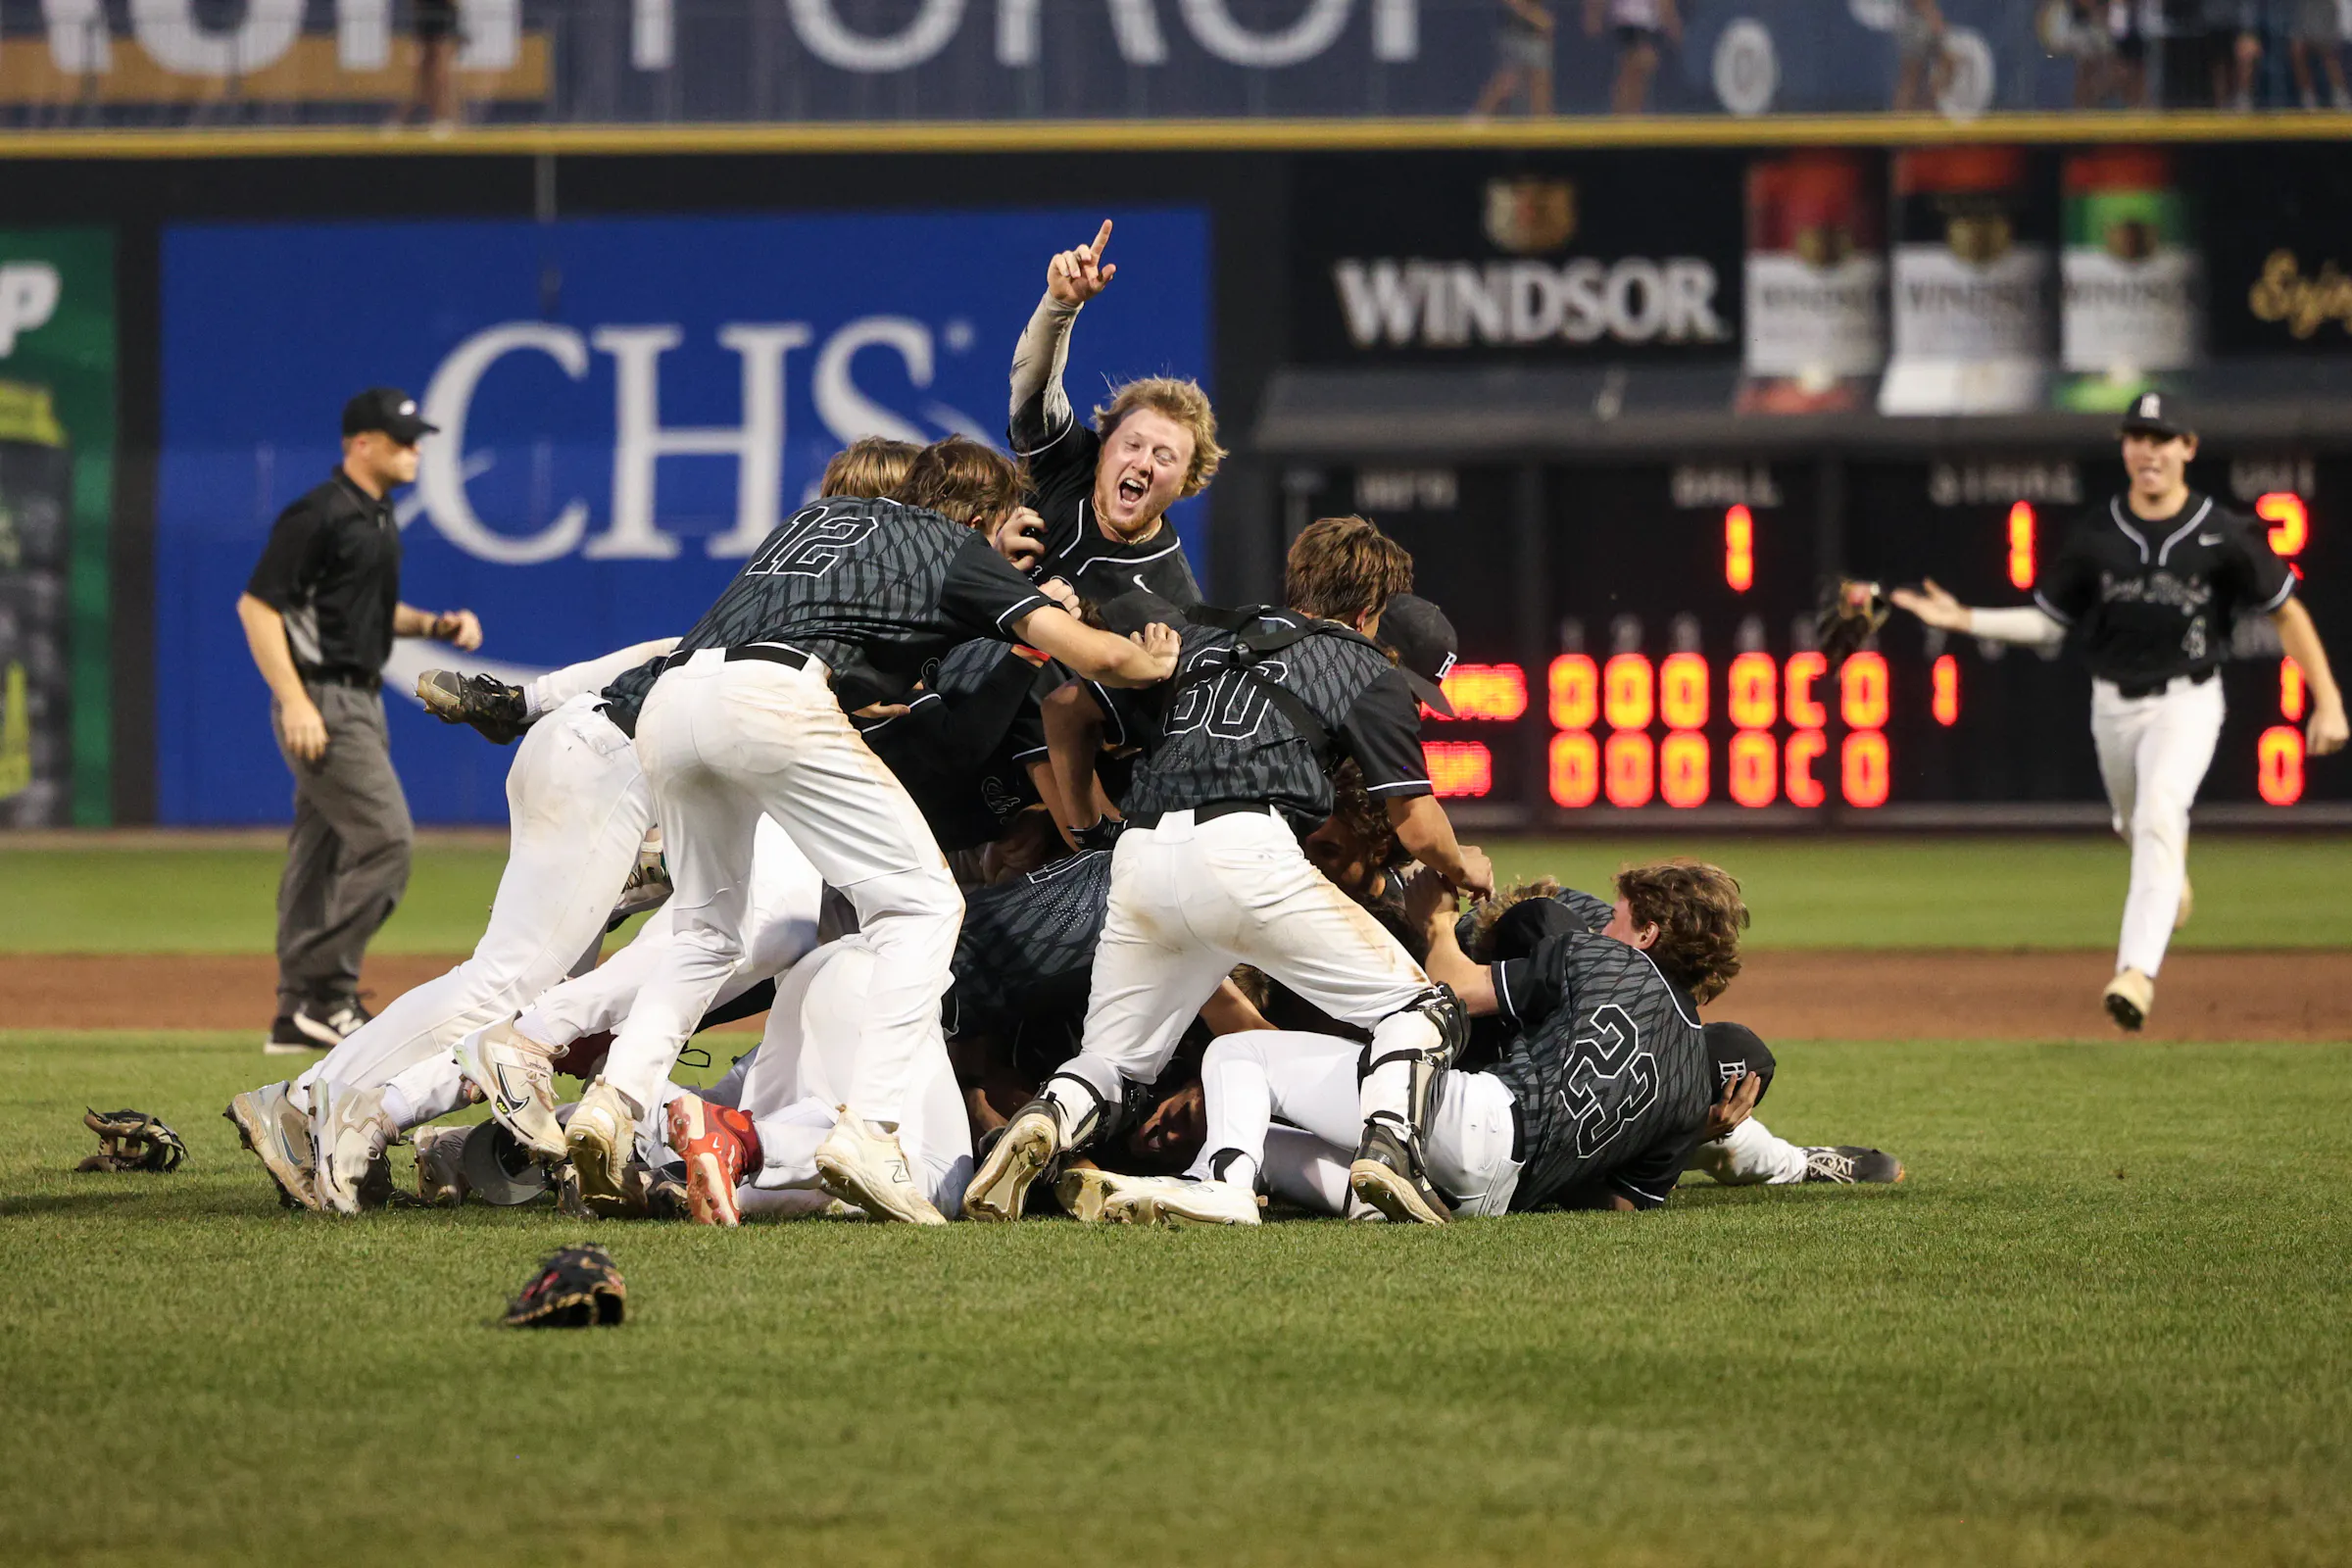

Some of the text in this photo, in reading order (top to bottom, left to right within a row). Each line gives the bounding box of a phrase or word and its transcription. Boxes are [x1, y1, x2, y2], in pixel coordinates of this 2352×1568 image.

[1336, 259, 1718, 346] WINDSOR
[416, 316, 934, 564] CHS
[745, 505, 880, 579] 12
[1726, 504, 1754, 592] 1
[2009, 501, 2036, 590] 1
[1161, 646, 1289, 740] 30
[1933, 654, 1959, 726] 1
[2279, 655, 2306, 722] 1
[2257, 725, 2306, 807] 0
[1558, 1004, 1660, 1159] 23
